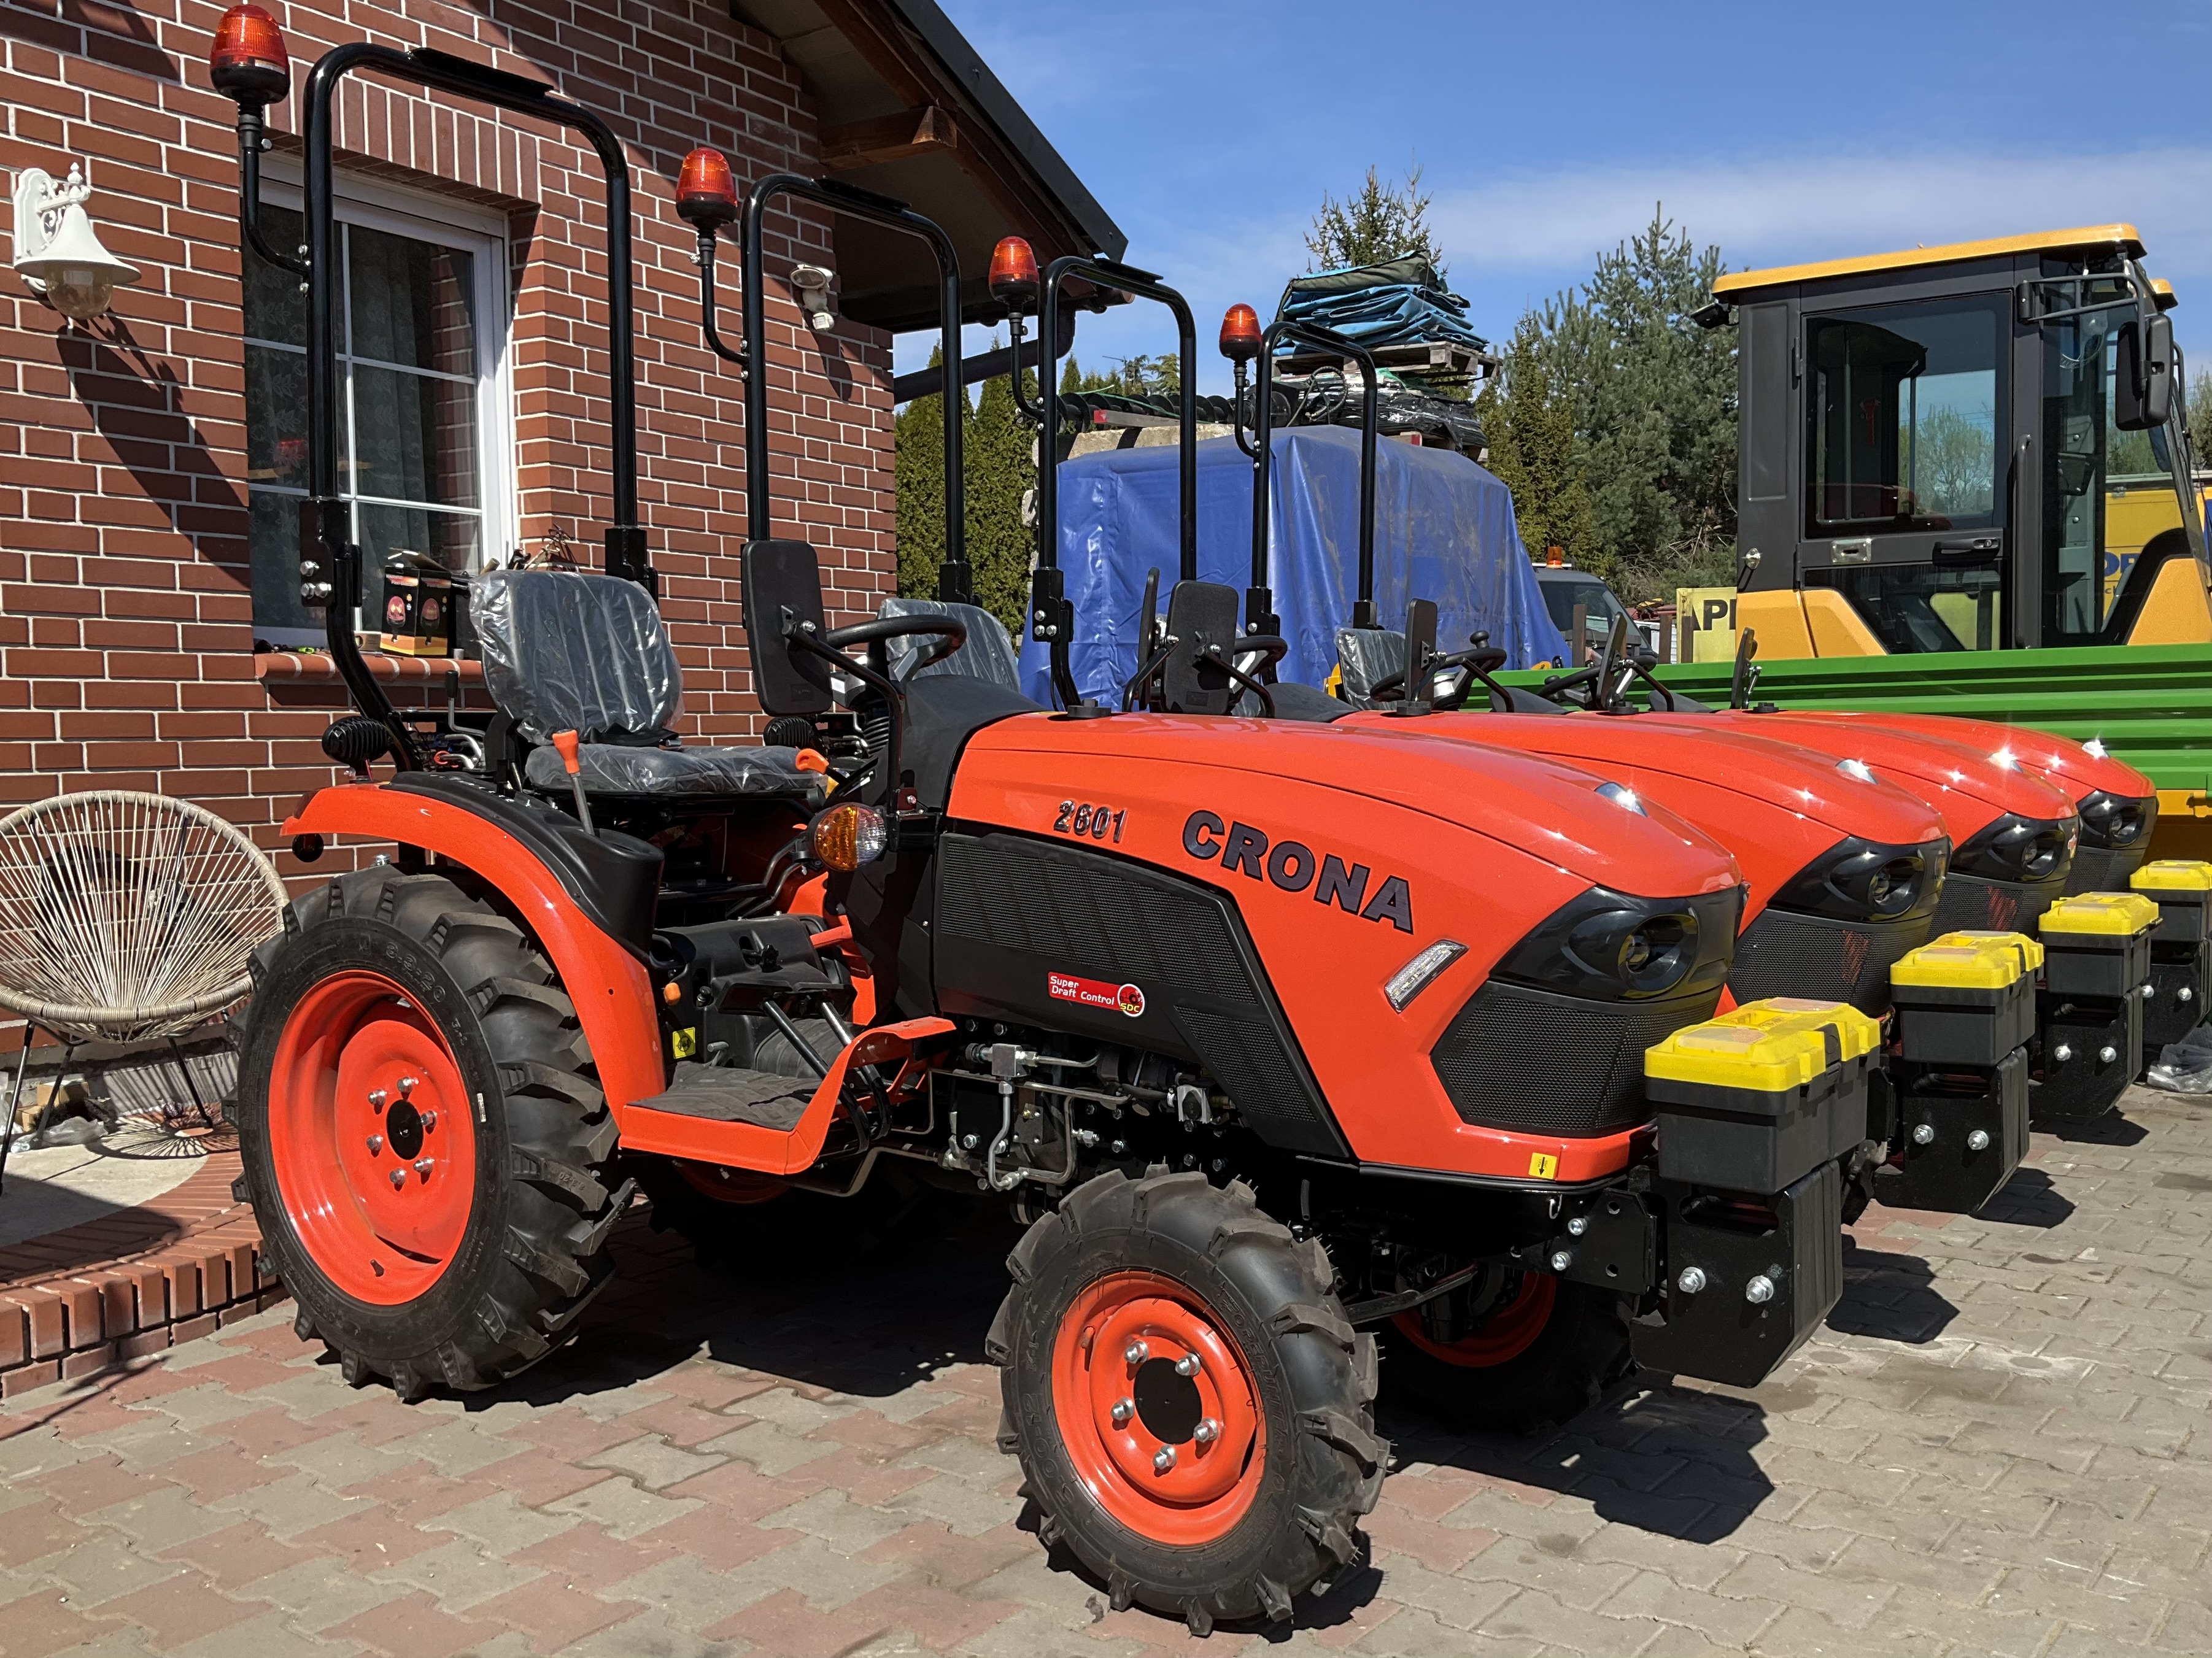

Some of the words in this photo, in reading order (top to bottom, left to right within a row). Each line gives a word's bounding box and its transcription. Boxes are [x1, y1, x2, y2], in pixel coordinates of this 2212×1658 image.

[1054, 800, 1127, 844] 2601
[1182, 810, 1413, 935] CRONA
[1050, 976, 1079, 988] Super
[1051, 985, 1077, 998] Draft
[1080, 991, 1115, 1005] Control
[1120, 1003, 1140, 1012] SDC
